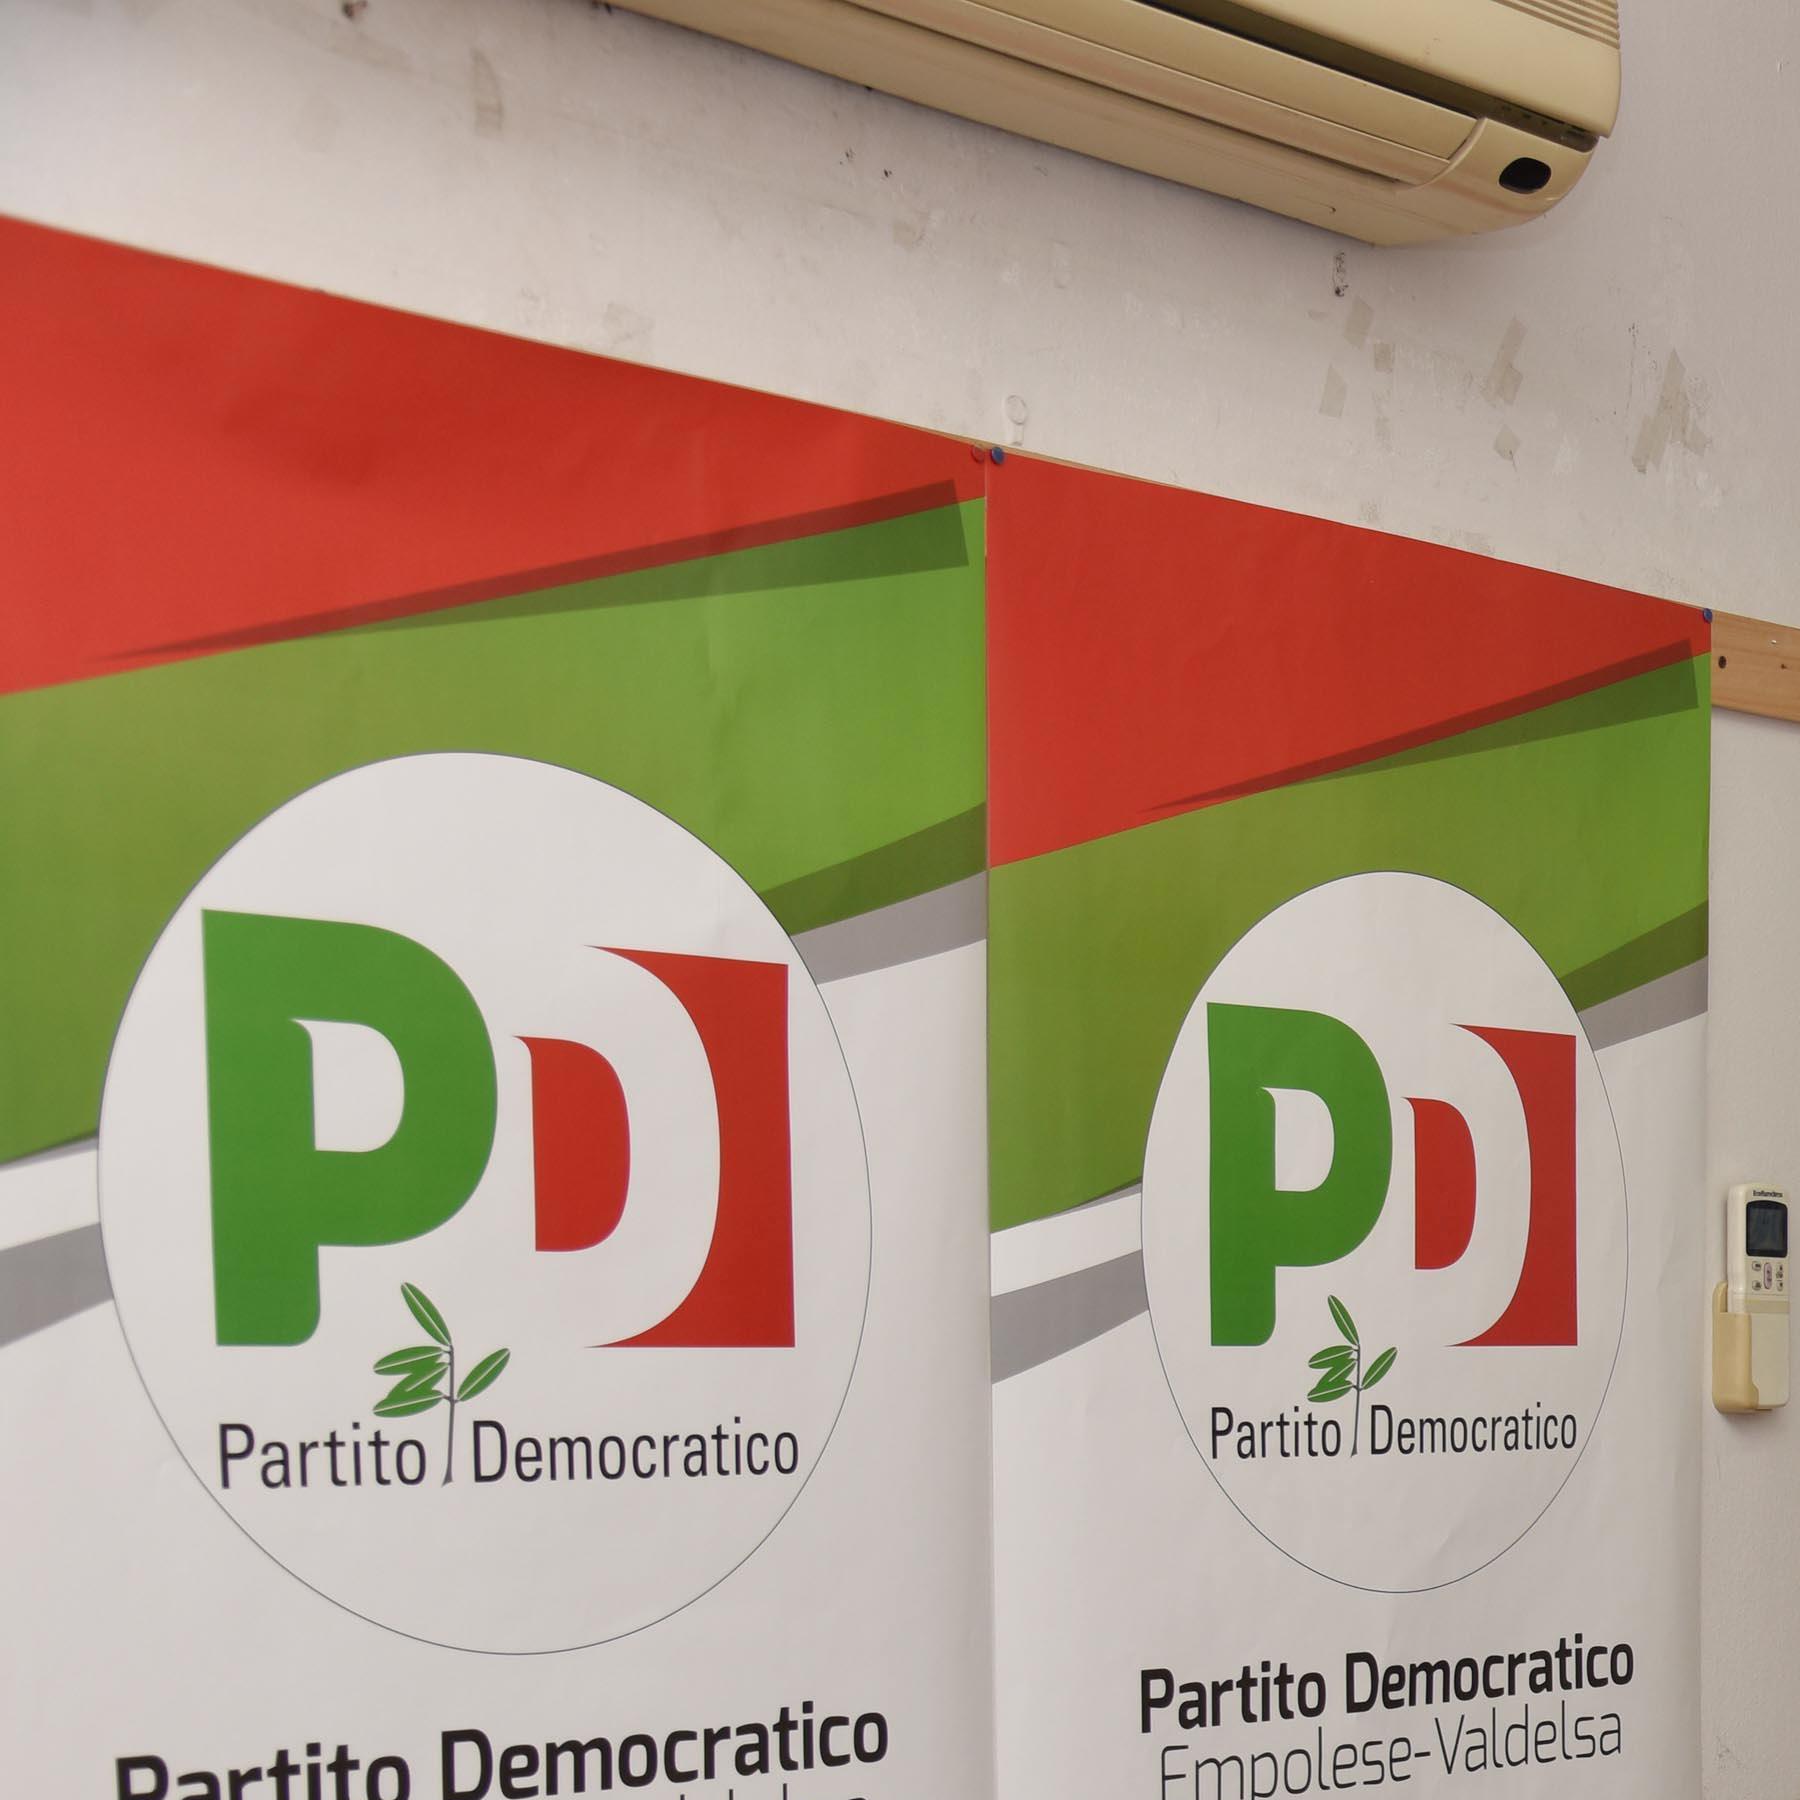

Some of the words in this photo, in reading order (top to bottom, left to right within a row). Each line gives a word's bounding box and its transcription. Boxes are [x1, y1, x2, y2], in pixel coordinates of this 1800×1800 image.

[218, 1422, 428, 1490] Partito
[473, 1416, 800, 1483] Democratico
[1212, 1406, 1342, 1459] Partito
[1371, 1402, 1577, 1455] Democratico
[1141, 1661, 1327, 1734] Partito
[1346, 1632, 1635, 1714] Democratico
